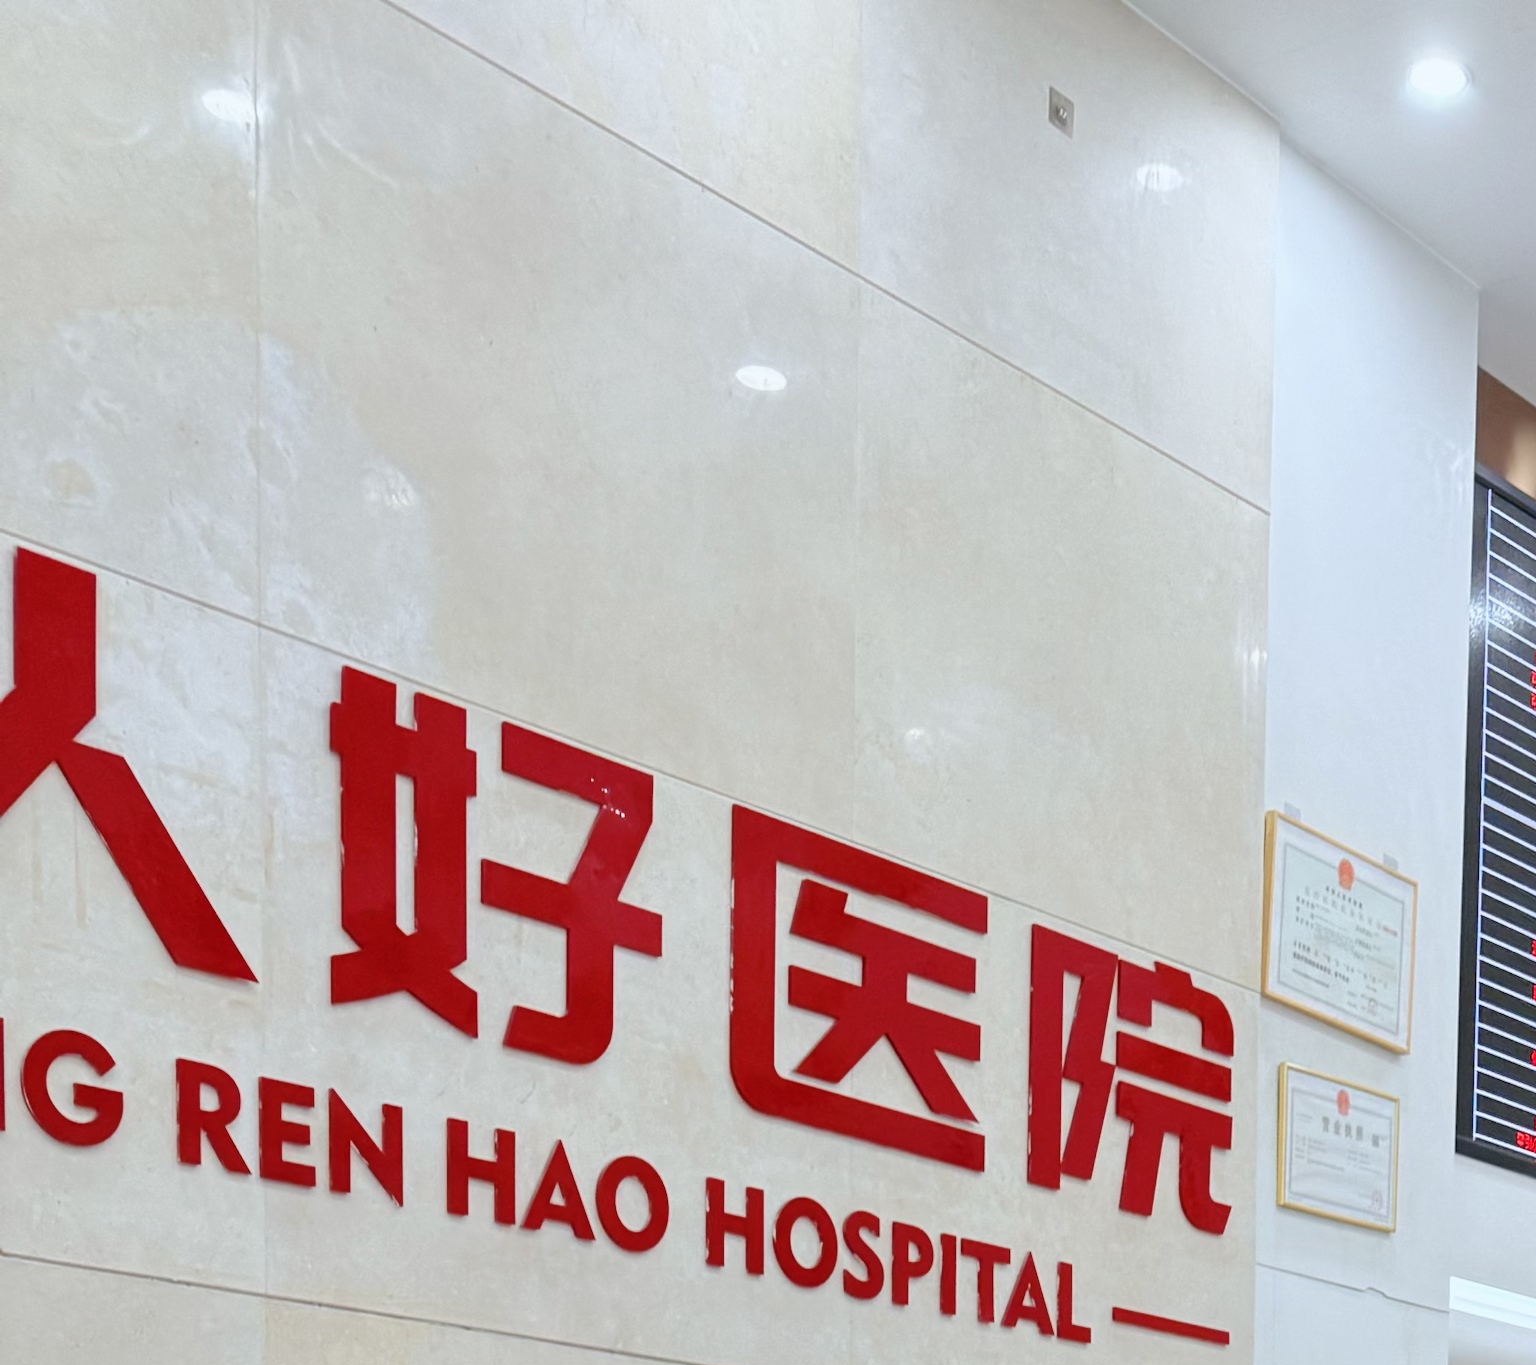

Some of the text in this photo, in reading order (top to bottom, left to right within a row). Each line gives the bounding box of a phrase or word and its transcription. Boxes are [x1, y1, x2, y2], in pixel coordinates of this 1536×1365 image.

[175, 1057, 404, 1208] REN
[446, 1117, 670, 1253] HAO
[705, 1177, 1092, 1344] HOSPITAL
